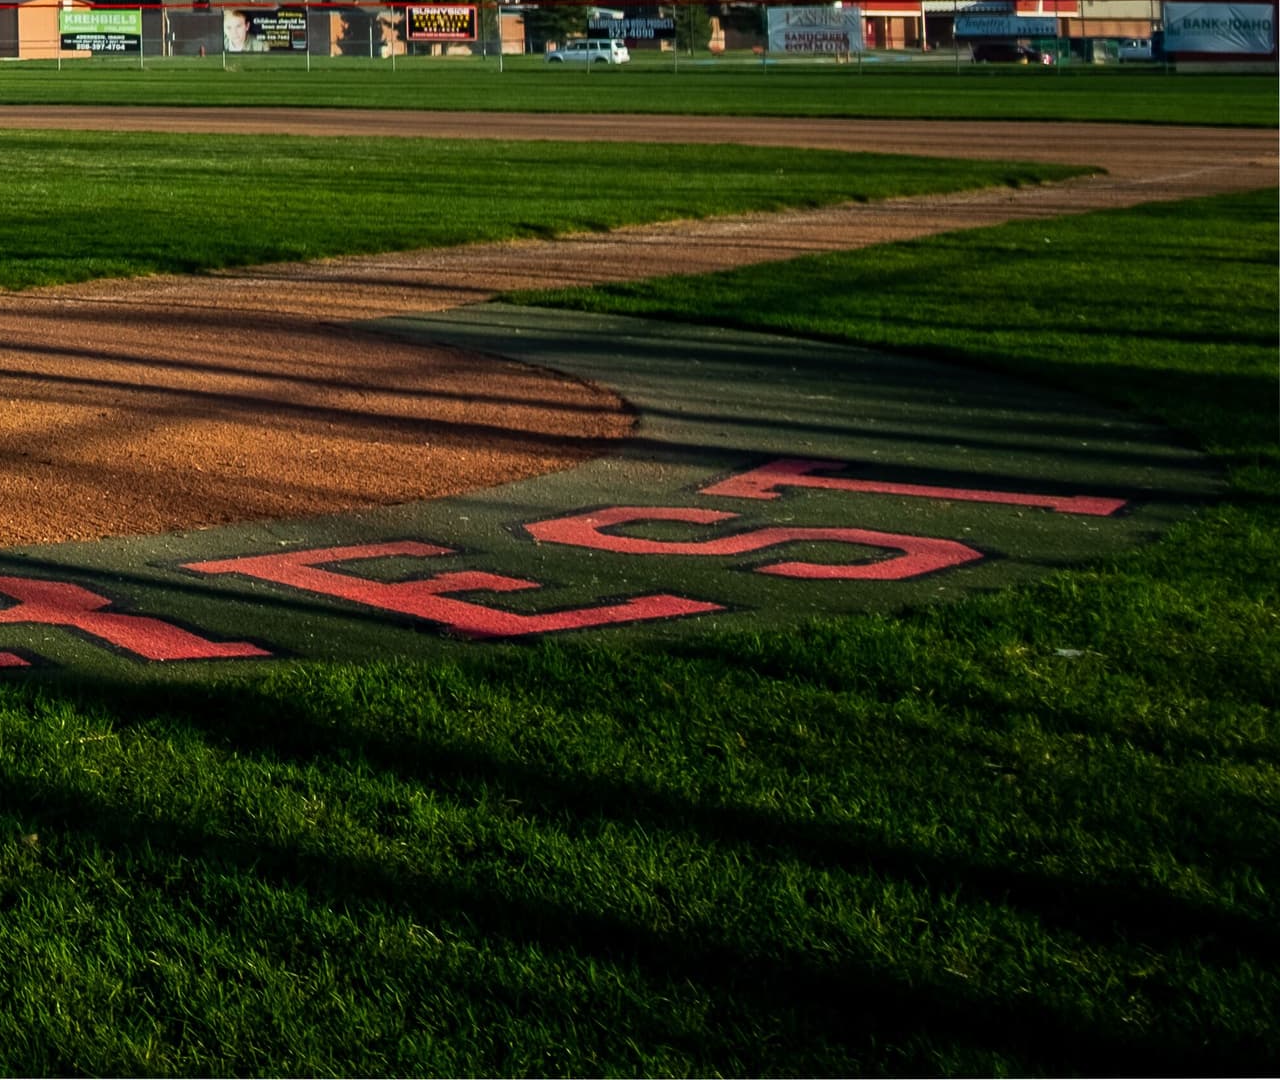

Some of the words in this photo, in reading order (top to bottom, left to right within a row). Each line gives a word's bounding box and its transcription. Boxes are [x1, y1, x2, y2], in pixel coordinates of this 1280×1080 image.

[412, 7, 469, 15] SUNNYSIDE
[1183, 18, 1217, 29] BANK
[1228, 18, 1271, 31] IDAHO
